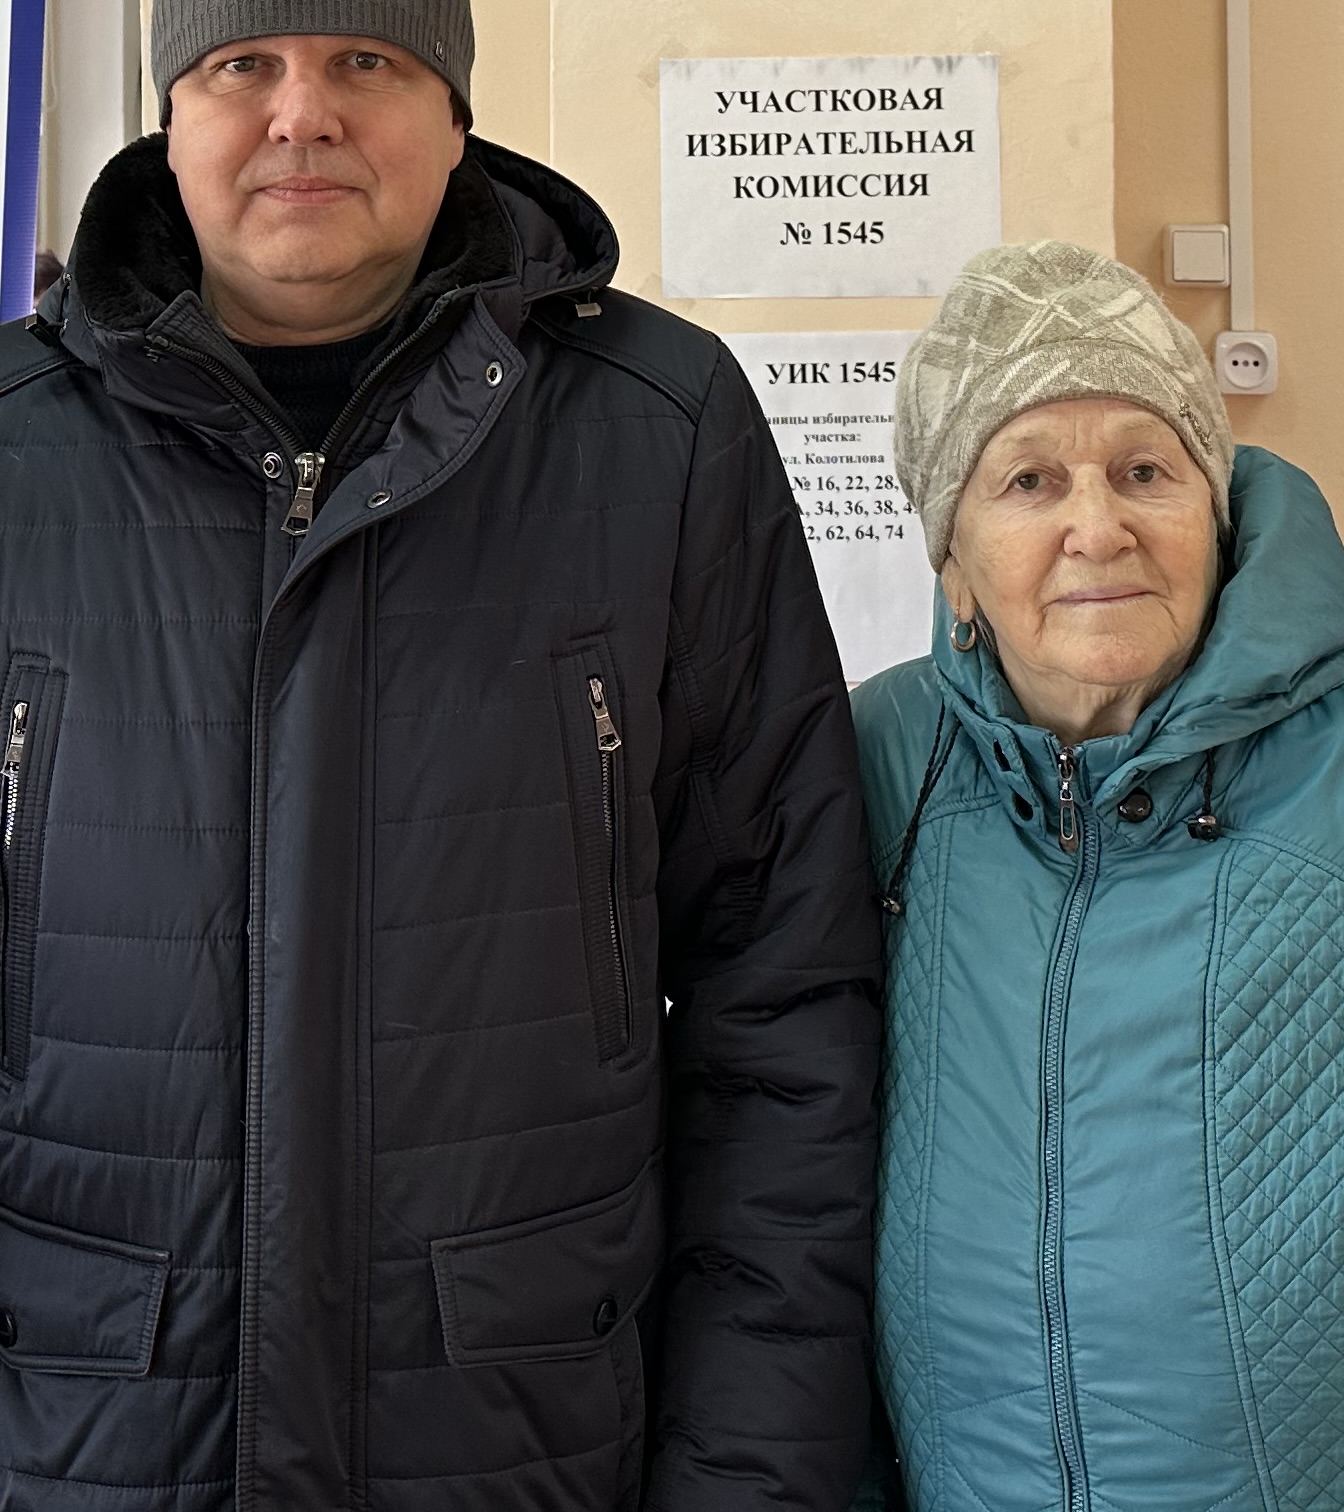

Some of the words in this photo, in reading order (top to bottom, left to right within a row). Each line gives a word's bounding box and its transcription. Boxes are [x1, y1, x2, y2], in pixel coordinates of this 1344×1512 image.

[714, 87, 944, 114] УЧАСТКОВАЯ
[686, 129, 975, 157] ИЗБИРАТЕЛЬНАЯ
[733, 173, 929, 199] КОМИССИЯ
[780, 222, 812, 246] №
[823, 221, 885, 245] 1545
[765, 362, 830, 385] УИК
[839, 361, 896, 383] 1545
[766, 416, 808, 426] аницы
[812, 413, 895, 427] избирательн
[805, 452, 885, 465] Колотилова
[817, 475, 840, 492] 16,
[845, 475, 870, 492] 22,
[874, 474, 899, 491] 28,
[814, 500, 839, 518] 34,
[844, 500, 869, 518] 36,
[873, 499, 898, 517] 38,
[903, 501, 918, 515] 4
[804, 525, 821, 543] 2,
[826, 524, 850, 543] 62,
[854, 524, 880, 543] 64,
[885, 524, 904, 540] 74
